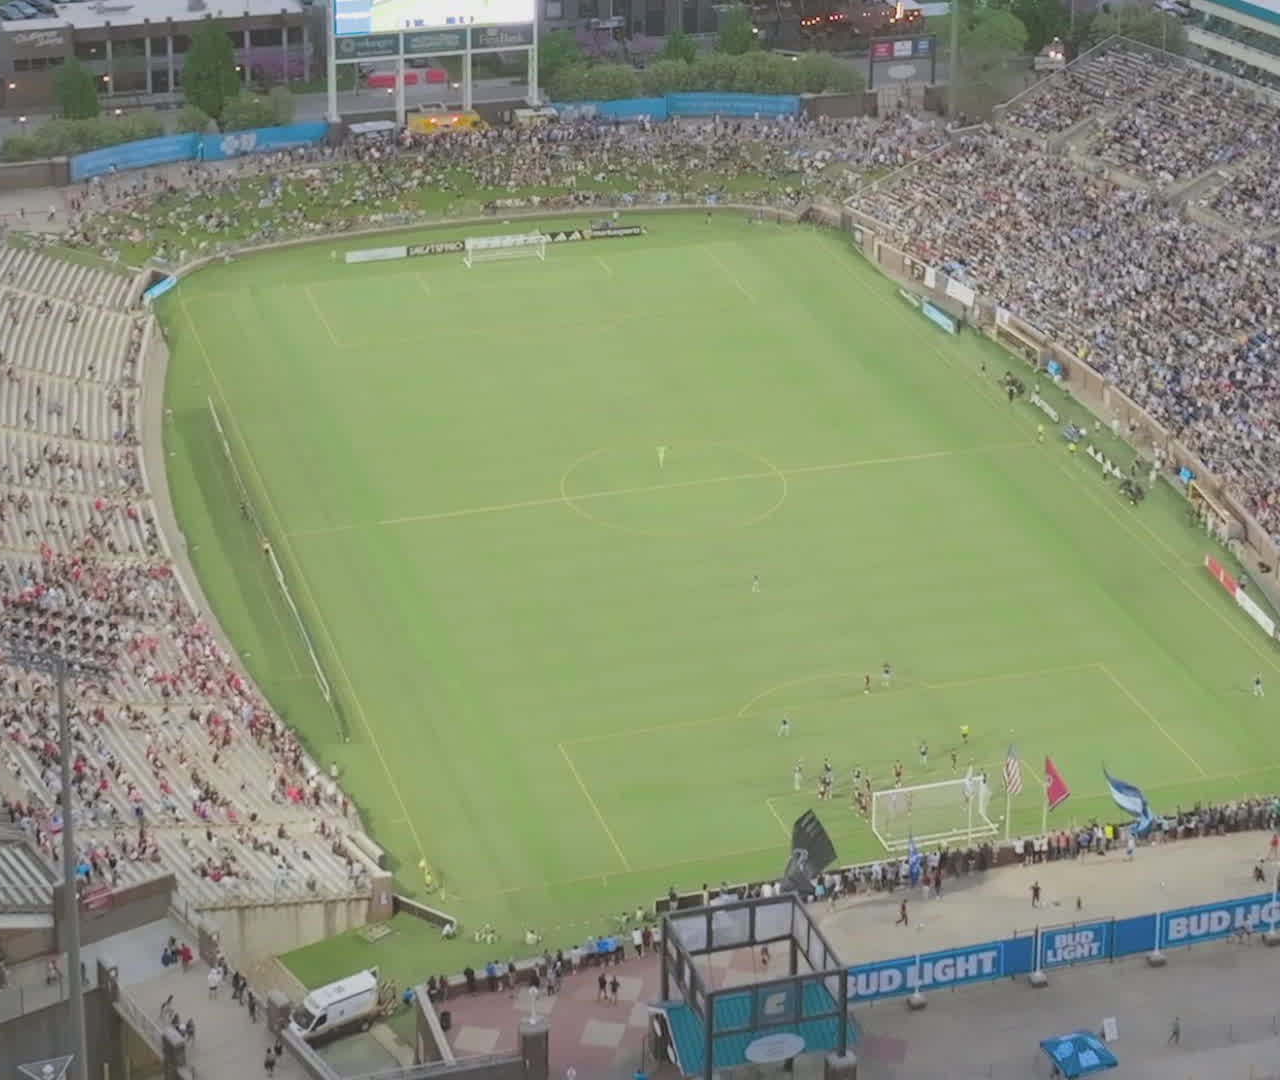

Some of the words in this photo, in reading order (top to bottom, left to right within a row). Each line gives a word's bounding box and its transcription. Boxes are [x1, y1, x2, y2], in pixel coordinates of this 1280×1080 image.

[1168, 909, 1231, 940] BUD
[1047, 941, 1101, 962] LIGHT
[1055, 930, 1095, 948] BUD
[829, 968, 902, 998] BUD
[906, 951, 998, 988] LIGHT
